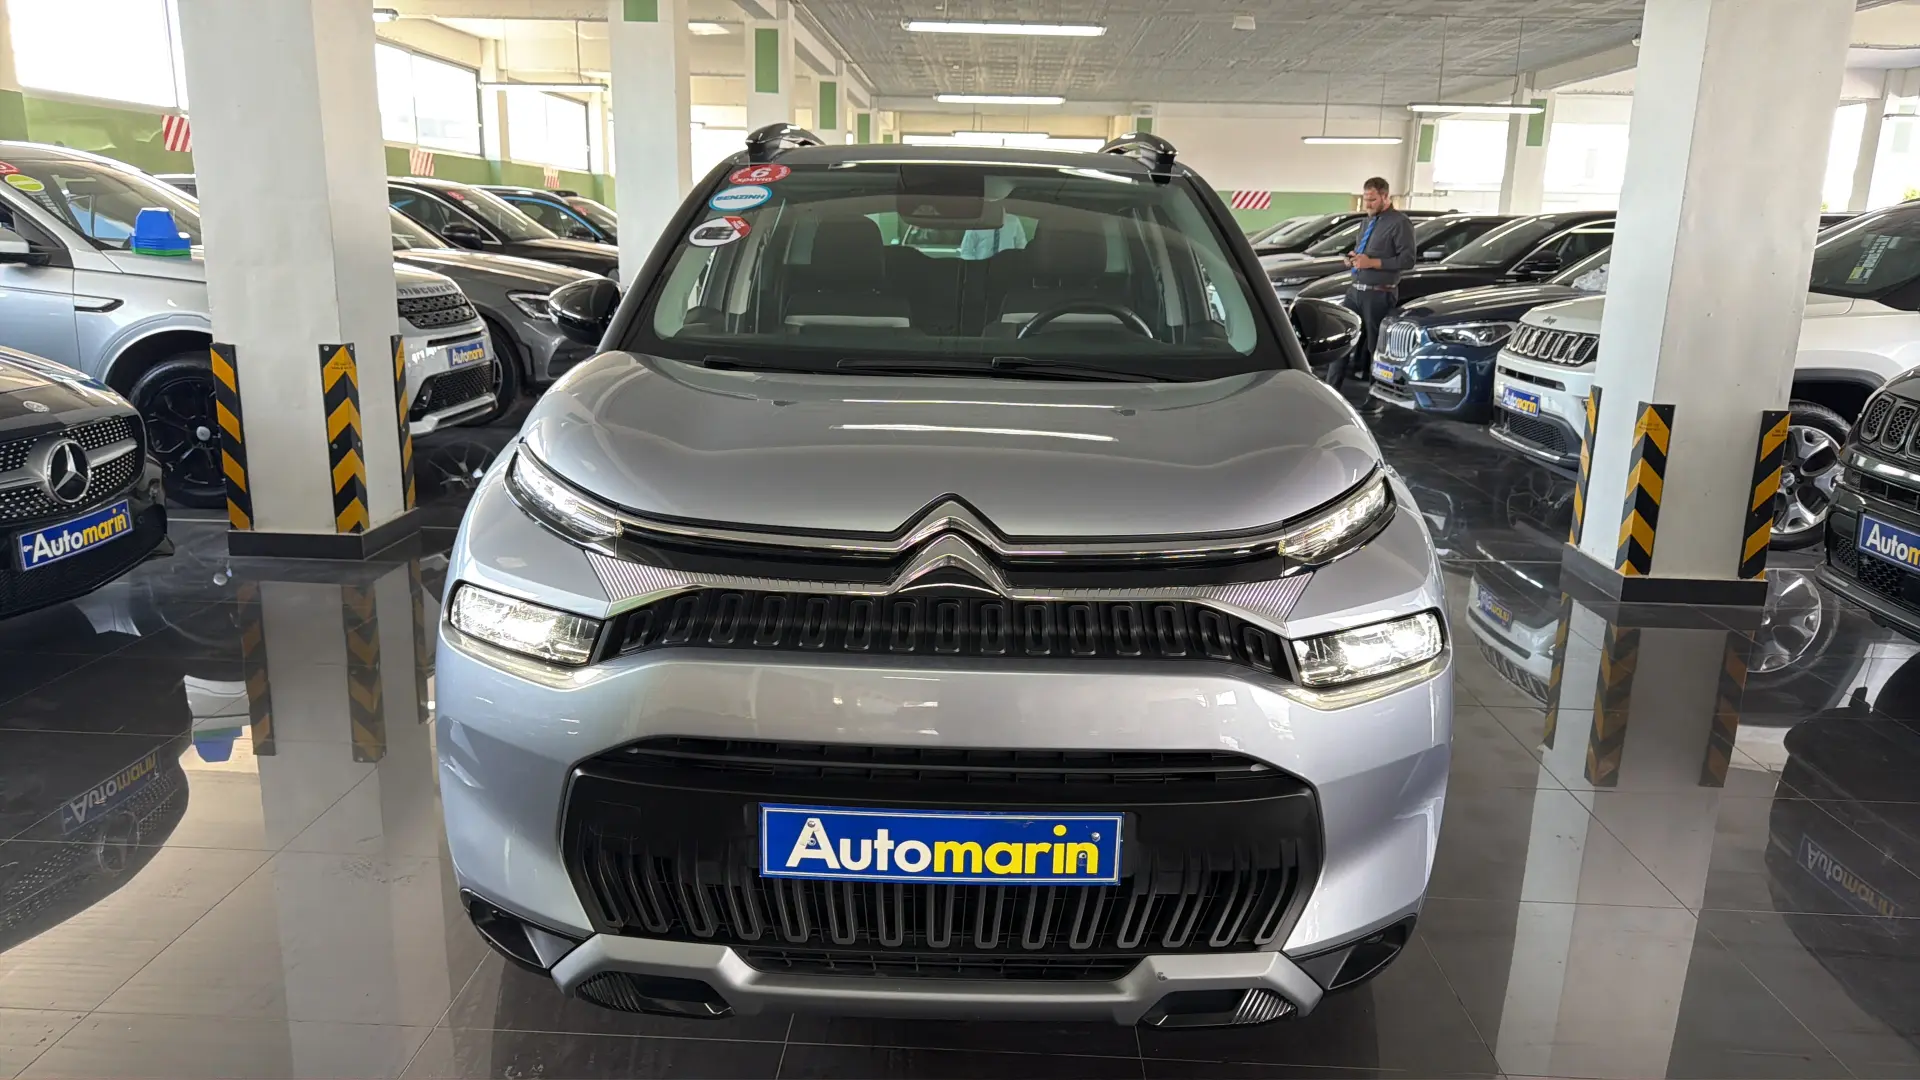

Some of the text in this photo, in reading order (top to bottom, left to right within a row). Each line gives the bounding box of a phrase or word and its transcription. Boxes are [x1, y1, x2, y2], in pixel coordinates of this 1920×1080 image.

[750, 167, 772, 178] 6
[452, 343, 485, 365] Automarin
[32, 508, 127, 563] Automarin
[786, 817, 1098, 875] Automarin
